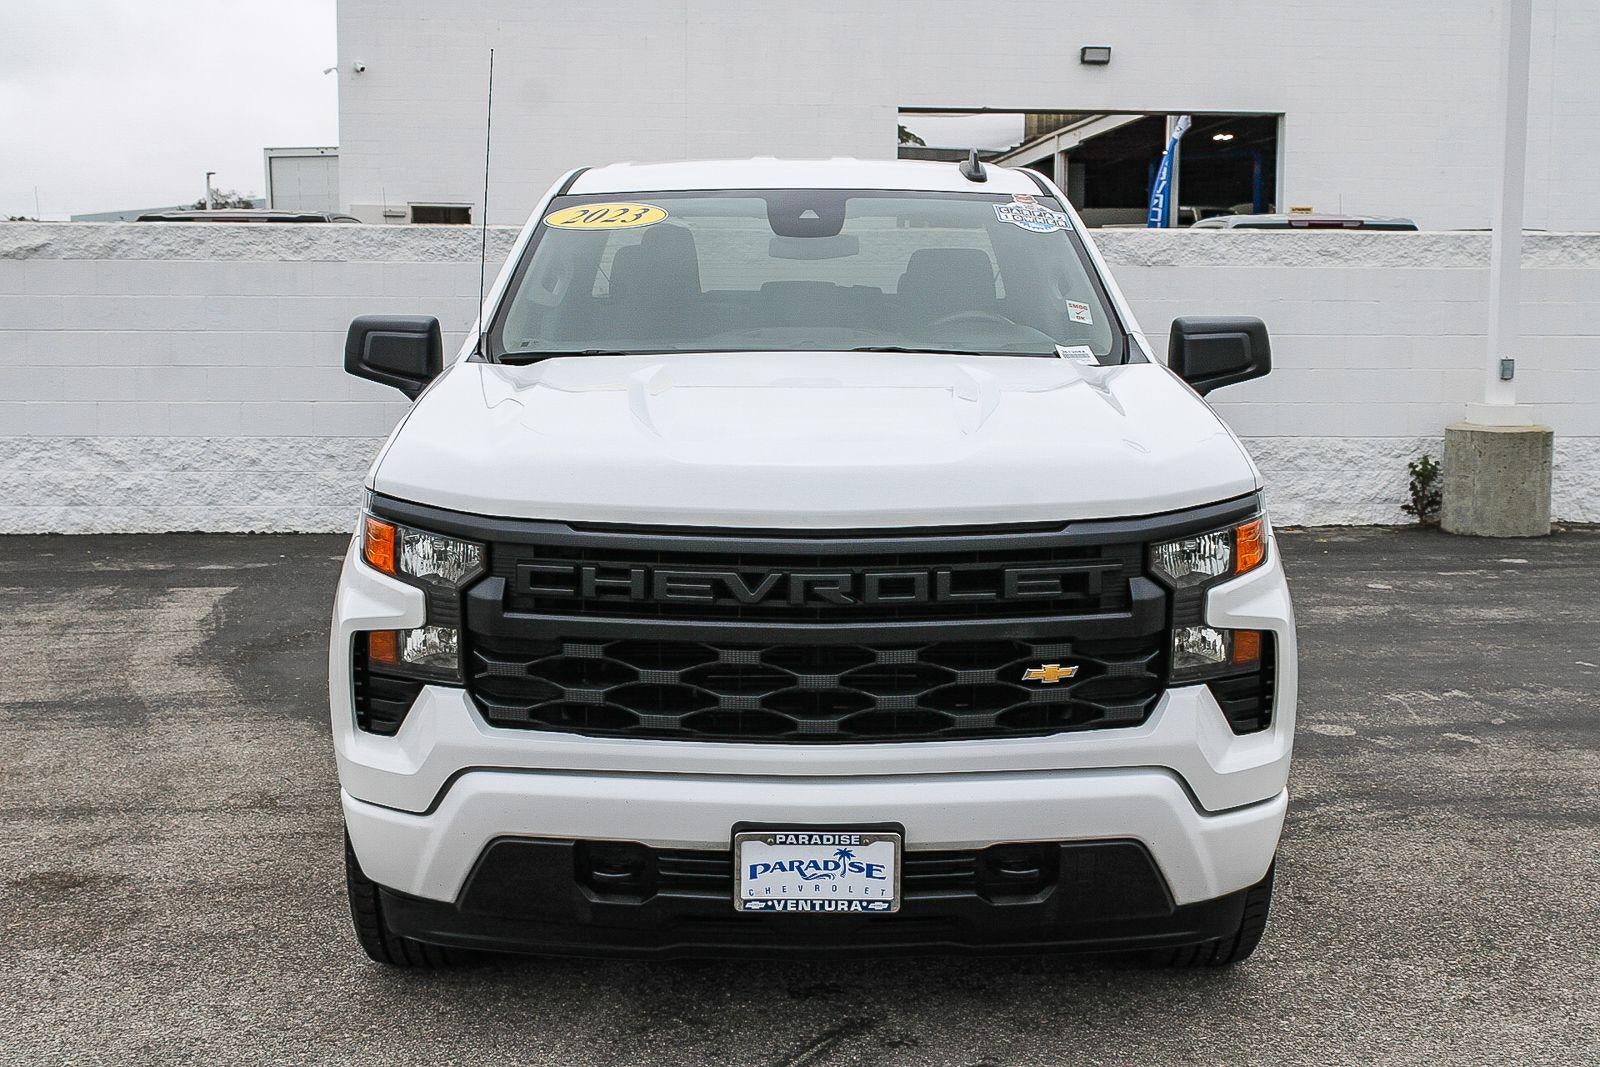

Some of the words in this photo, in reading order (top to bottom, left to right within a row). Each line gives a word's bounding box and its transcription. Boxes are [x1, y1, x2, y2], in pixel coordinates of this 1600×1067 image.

[561, 208, 650, 224] 2023
[515, 562, 1124, 603] CHEVROLET
[776, 835, 860, 845] PARADISE
[749, 849, 887, 880] PARADISE
[748, 884, 886, 897] CHEVROLET
[772, 900, 863, 911] VENTURA
